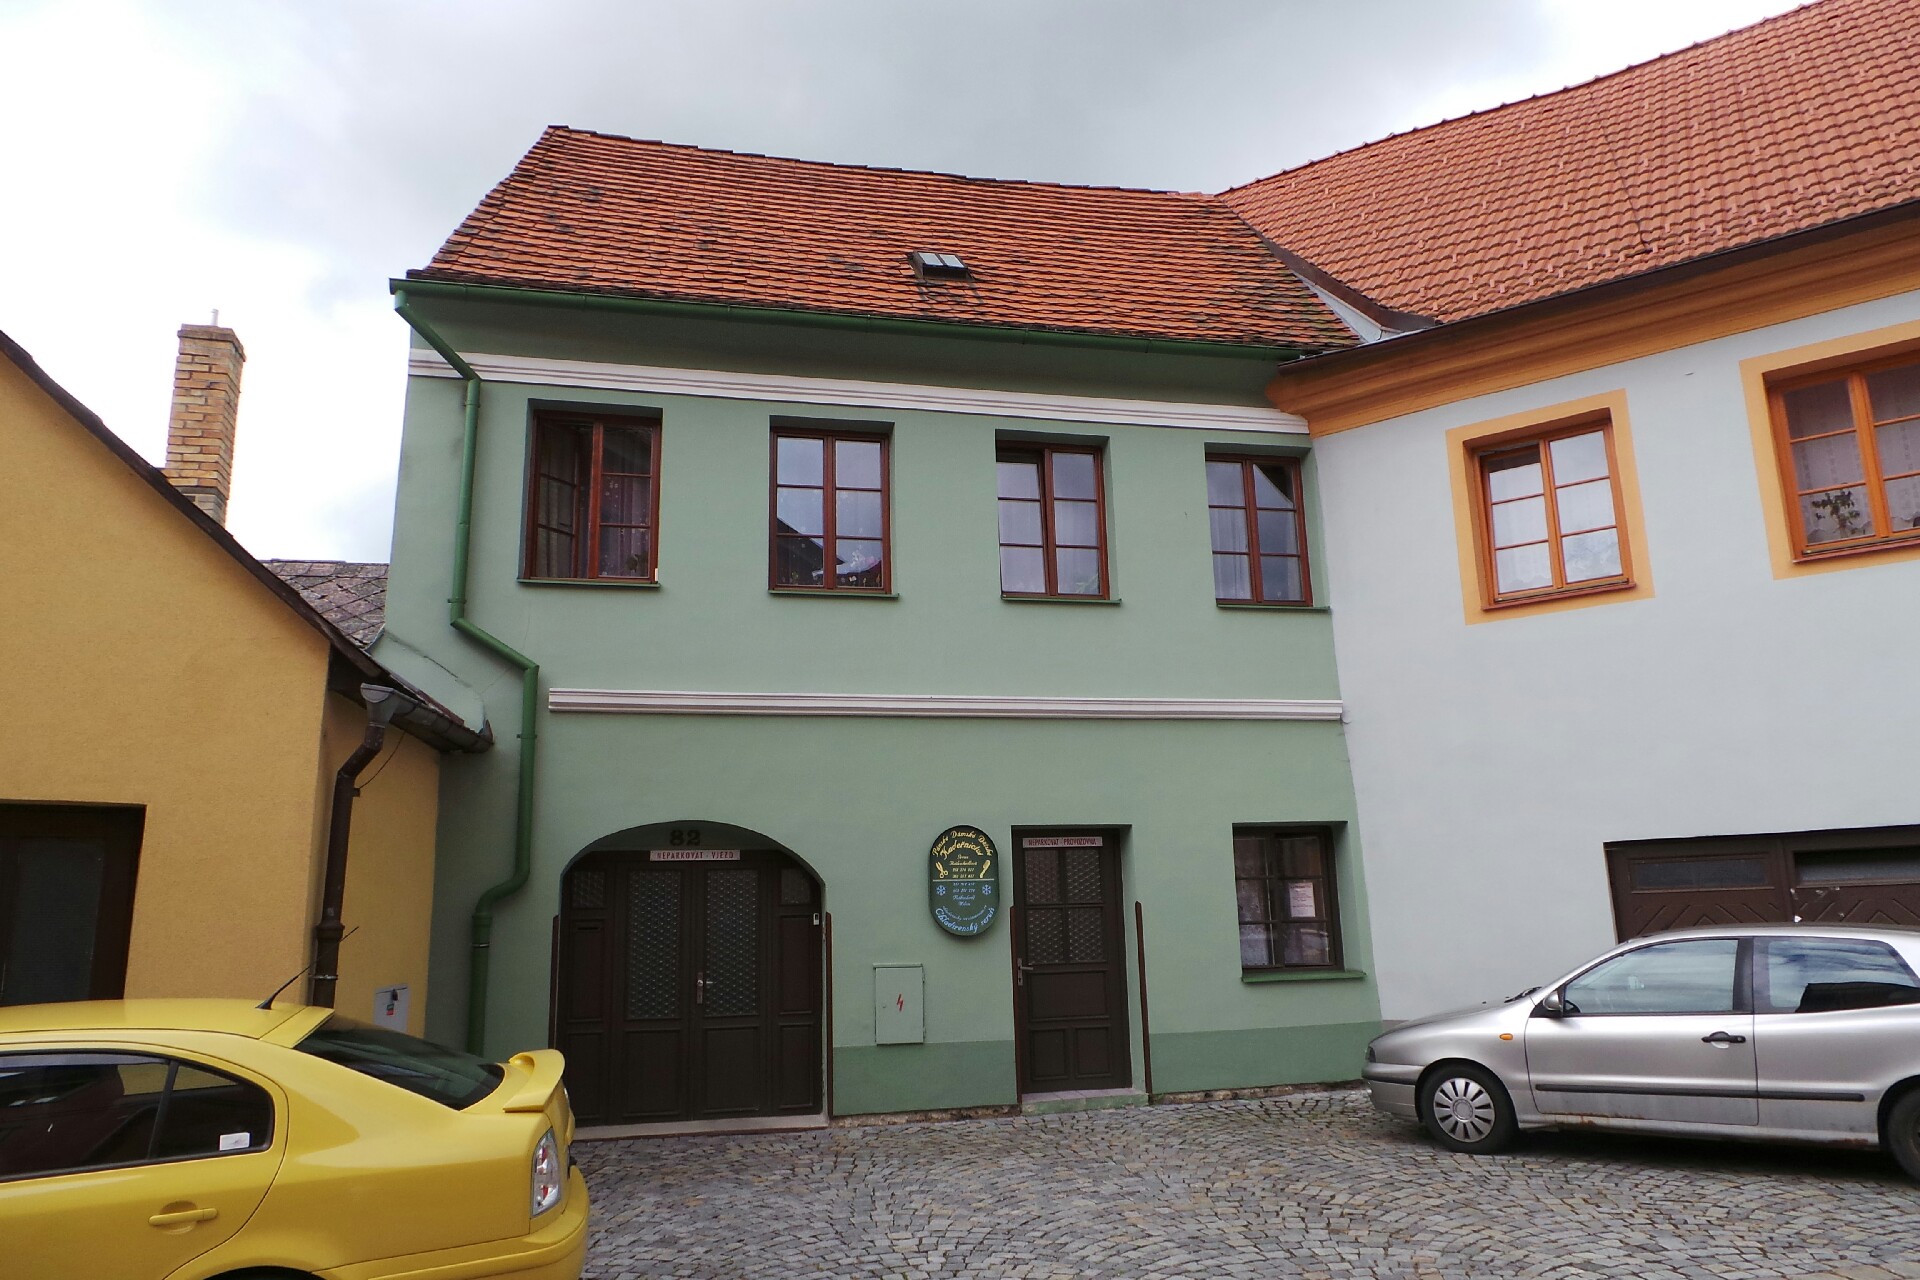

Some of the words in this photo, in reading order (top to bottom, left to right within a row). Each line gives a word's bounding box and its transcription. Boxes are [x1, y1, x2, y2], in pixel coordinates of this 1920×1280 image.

[669, 829, 701, 846] 82
[656, 851, 703, 859] NEPARKOVAT
[711, 851, 734, 859] VJEZD
